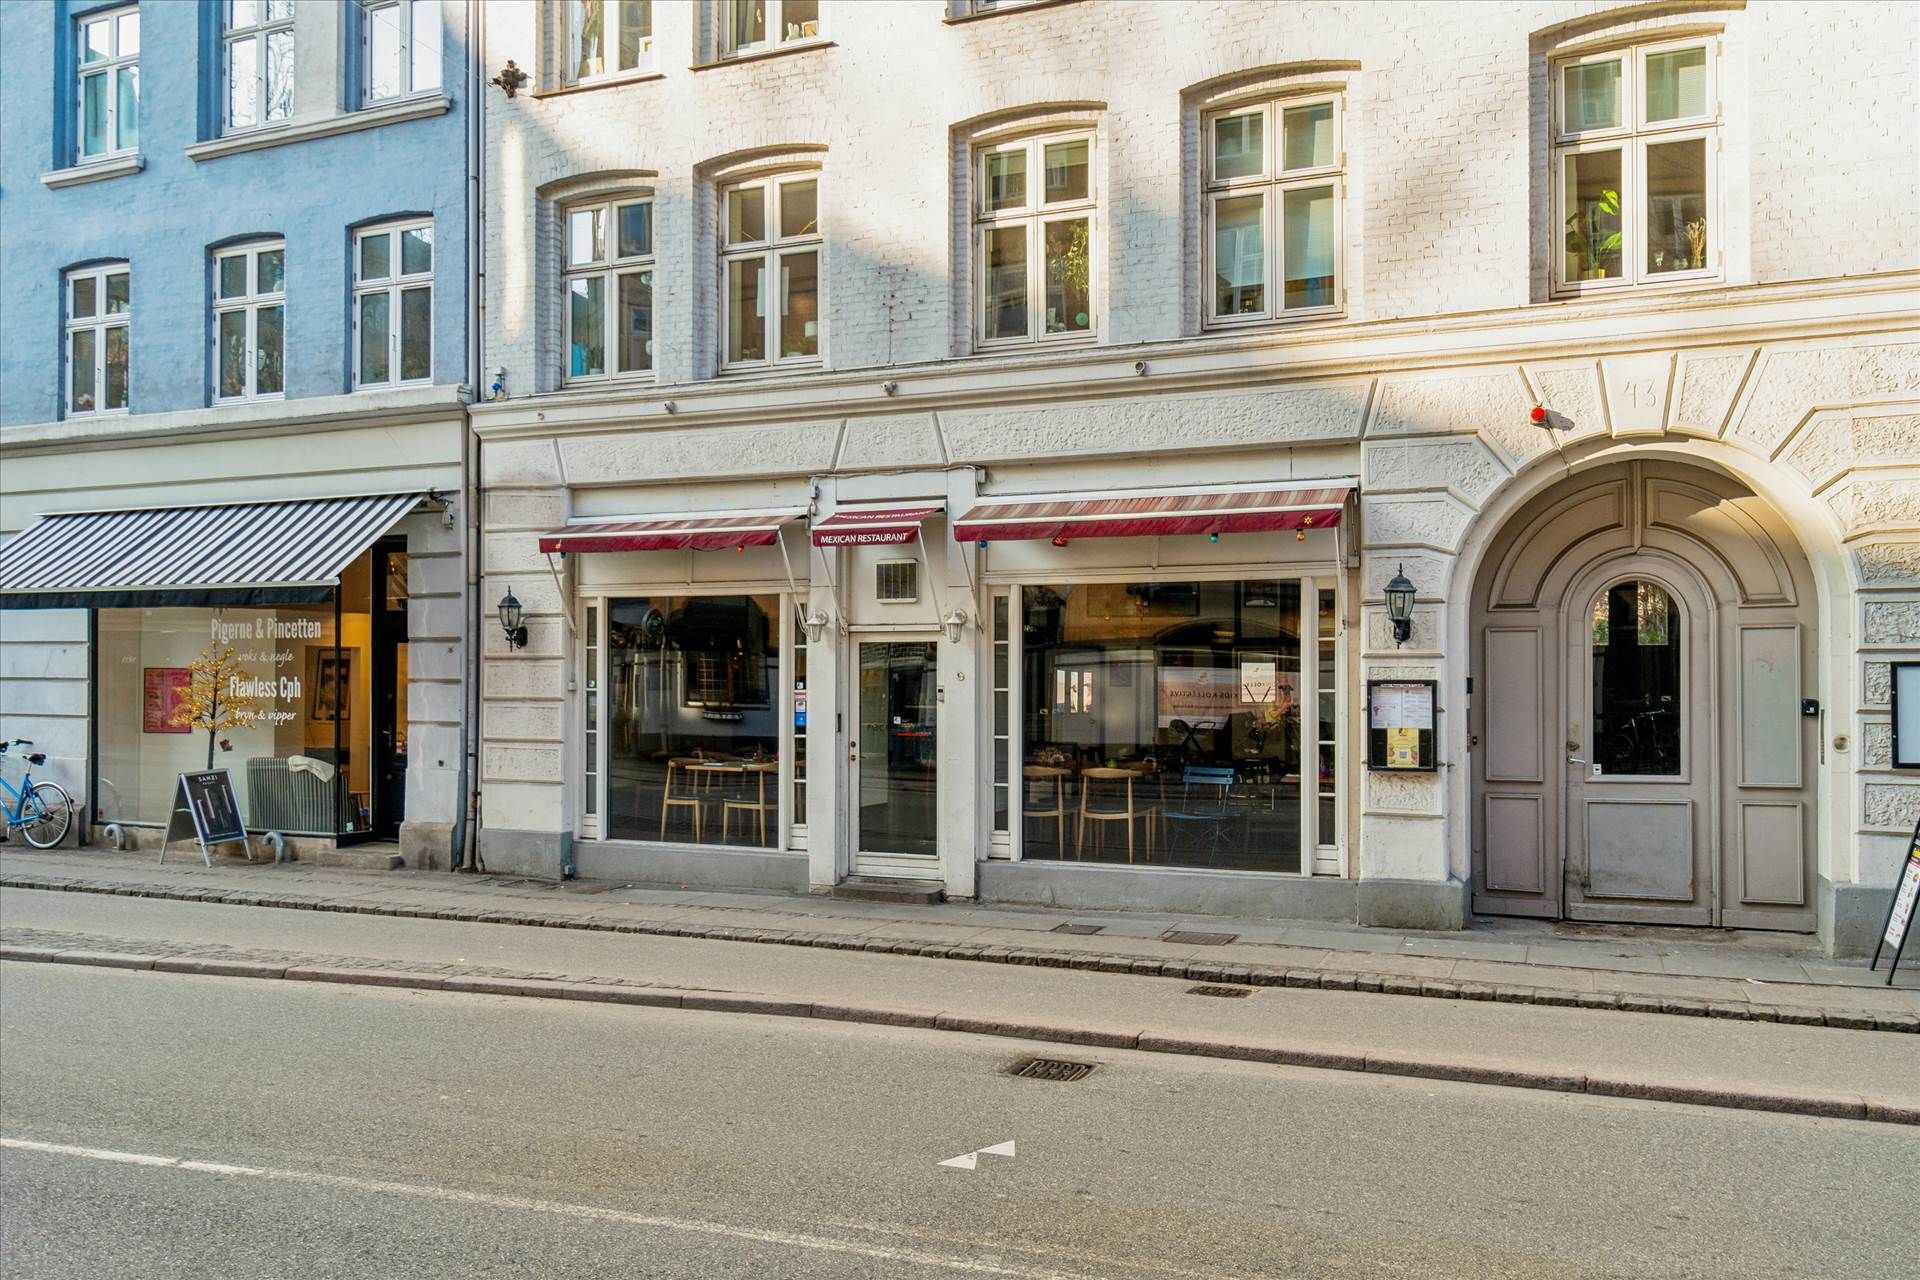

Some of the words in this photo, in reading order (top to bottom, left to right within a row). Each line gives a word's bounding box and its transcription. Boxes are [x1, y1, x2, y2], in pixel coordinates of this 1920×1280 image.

[820, 535, 857, 544] MEXICAN
[857, 532, 907, 543] RESTAURANT
[211, 618, 252, 644] Pigerne
[255, 618, 265, 639] &
[267, 617, 321, 639] Pincetten
[230, 676, 277, 698] Flawless
[280, 676, 301, 703] Cph
[258, 709, 267, 720] &
[268, 709, 297, 726] vipper
